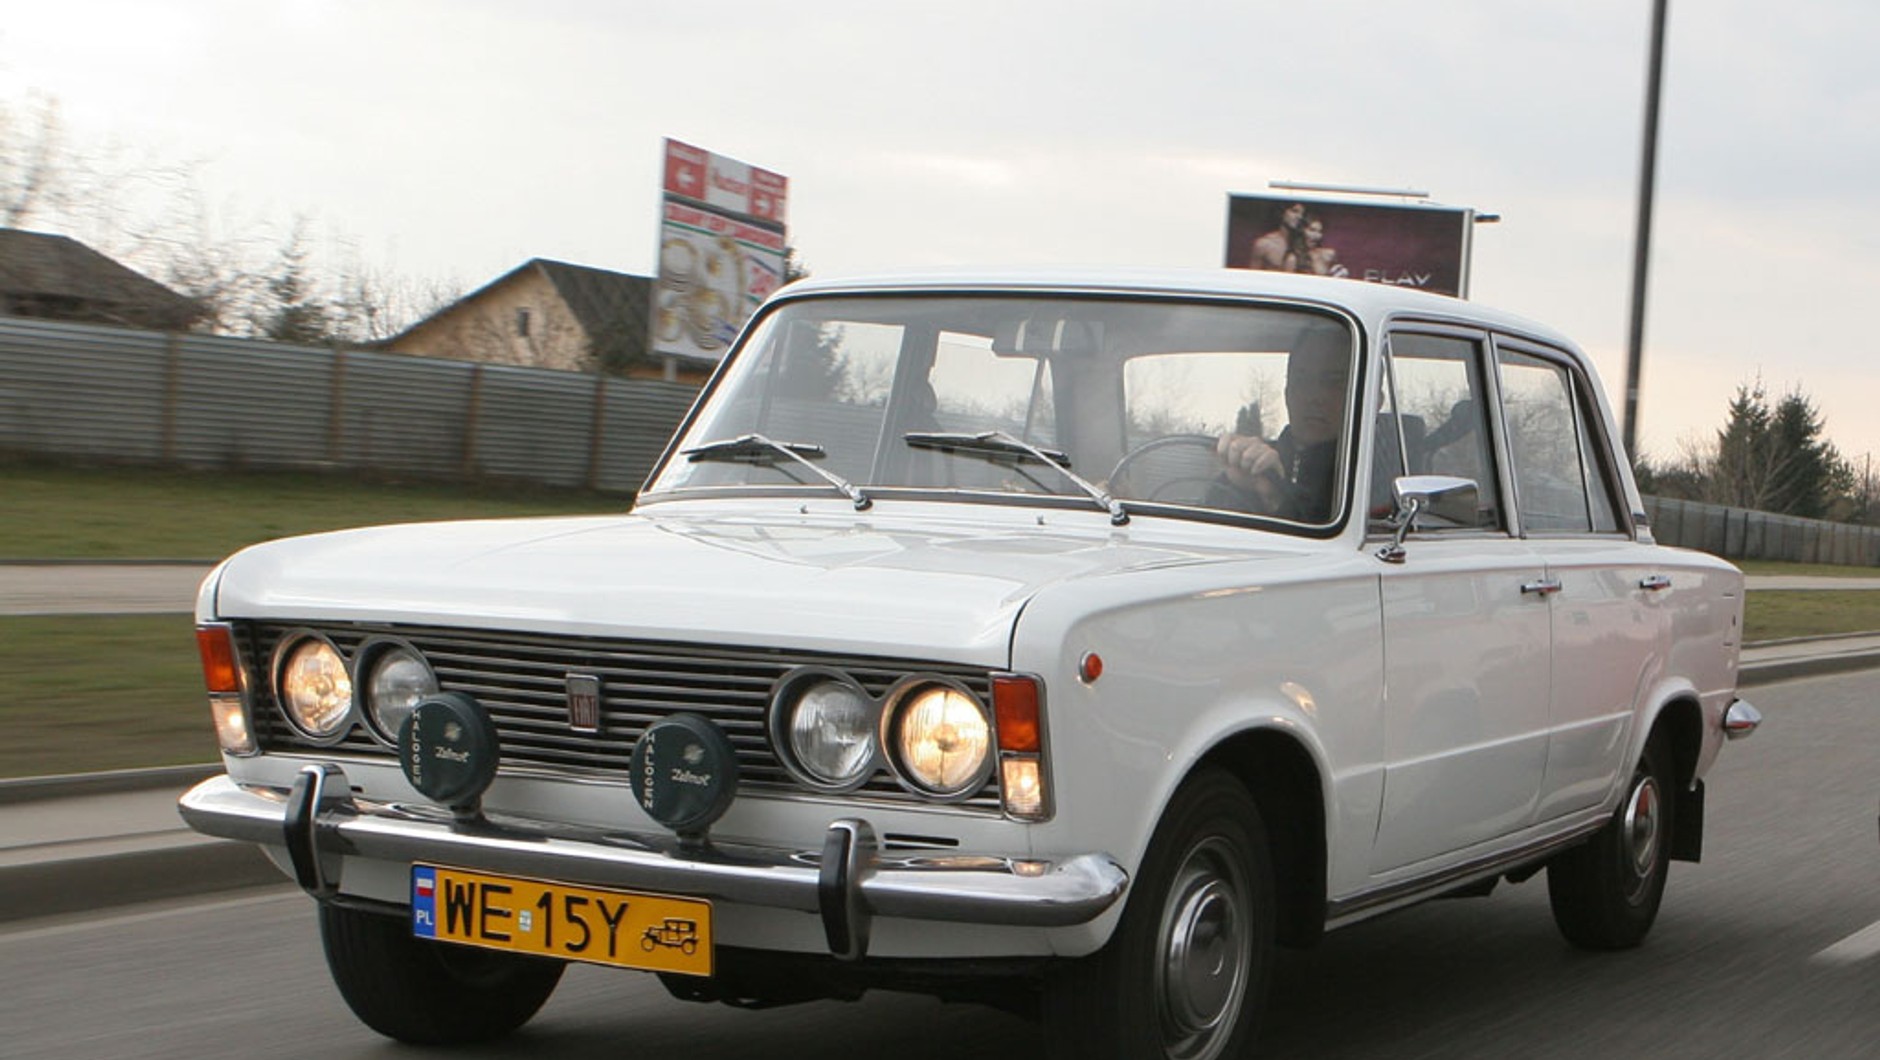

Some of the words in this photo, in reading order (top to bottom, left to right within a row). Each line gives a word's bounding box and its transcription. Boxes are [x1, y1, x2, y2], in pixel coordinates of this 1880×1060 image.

[1363, 268, 1432, 286] PLAY
[411, 710, 422, 785] HALOGEN
[644, 732, 656, 809] HALOGEN
[416, 909, 433, 926] PL
[444, 878, 513, 942] WE
[536, 891, 629, 958] 15Y
